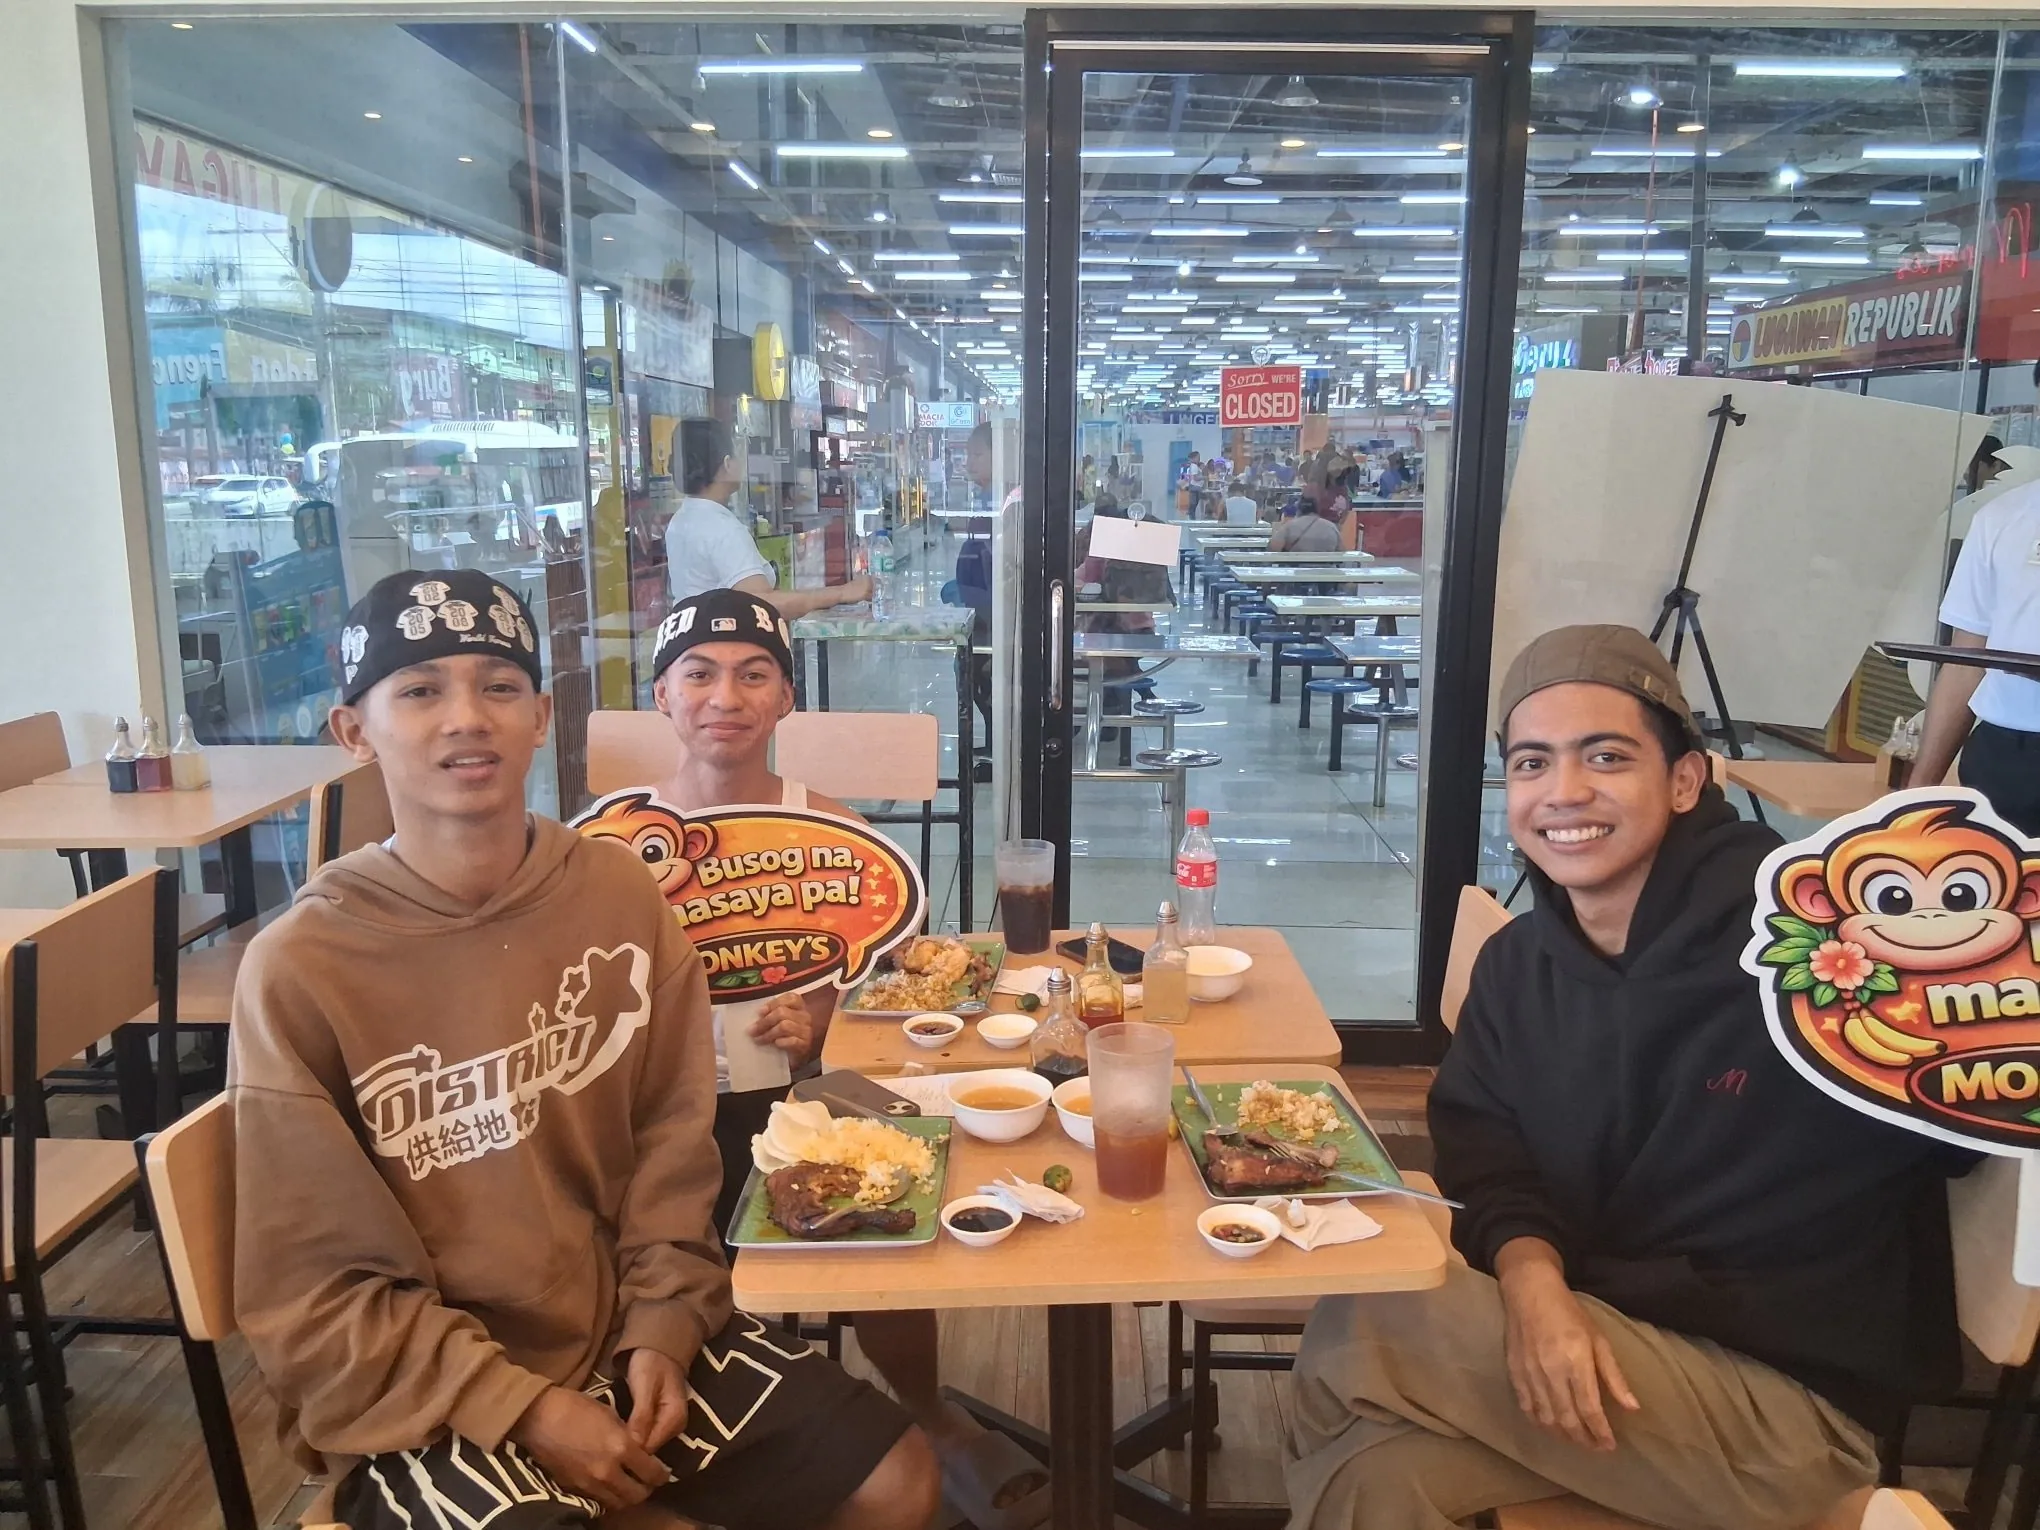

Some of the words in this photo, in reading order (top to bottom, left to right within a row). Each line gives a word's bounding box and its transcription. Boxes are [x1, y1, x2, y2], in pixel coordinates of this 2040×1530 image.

[1844, 284, 1962, 348] REPUBLIK
[1227, 373, 1266, 388] Sorry
[1271, 374, 1297, 384] WE'RE
[1225, 392, 1297, 420] CLOSED
[450, 607, 466, 618] 20
[697, 846, 804, 887] Busog
[811, 845, 864, 873] na,
[800, 874, 862, 912] pa!
[700, 935, 831, 974] ONKEY'S
[1940, 1061, 2040, 1105] MO
[406, 1107, 512, 1176] 供給地
